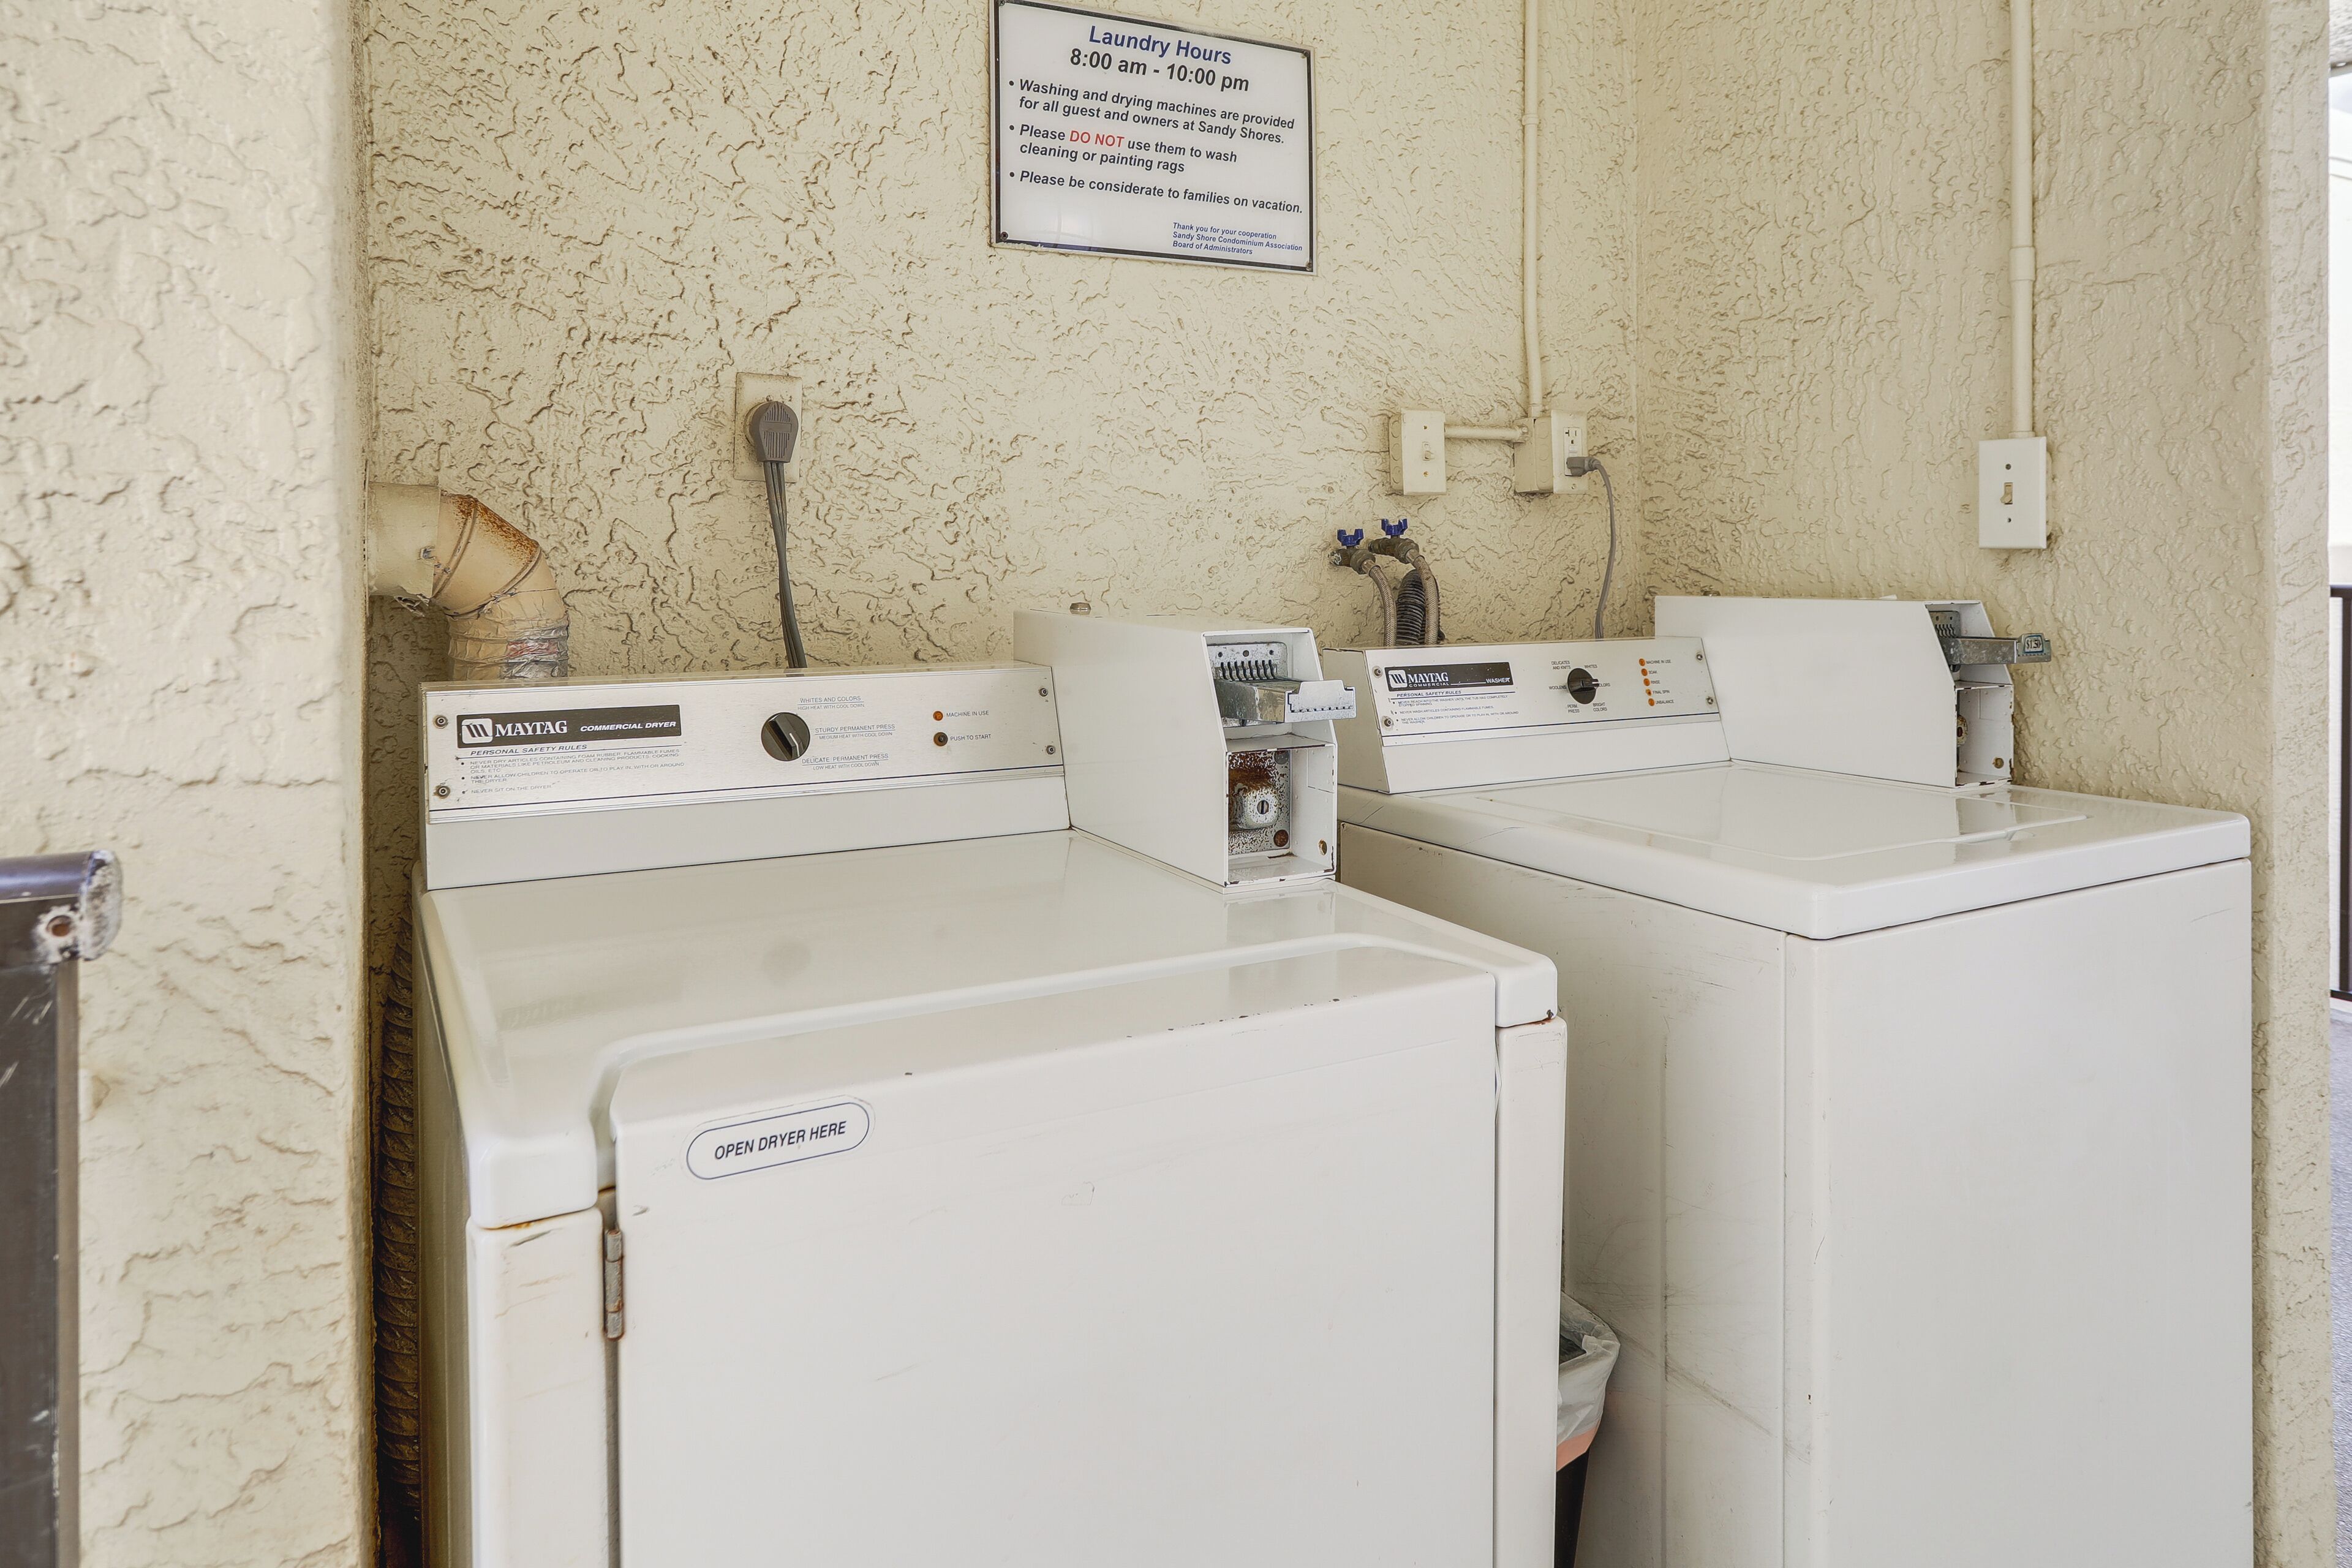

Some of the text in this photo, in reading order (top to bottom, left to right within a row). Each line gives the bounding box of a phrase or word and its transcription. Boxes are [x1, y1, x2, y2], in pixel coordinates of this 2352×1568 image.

[1089, 26, 1231, 64] Laundry Hours
[1070, 48, 1112, 70] 8:00
[1118, 59, 1147, 75] am
[1167, 63, 1216, 86] 10:00
[1221, 76, 1249, 91] pm
[1019, 96, 1284, 143] for all guest and owners at Sandy Shores.
[1020, 78, 1295, 129] Washing and drying machines are provided
[1020, 124, 1237, 162] Please DO NOT use them to wash
[1020, 142, 1185, 173] cleaning or painting rags
[1020, 170, 1303, 213] Please be considerate to families on vacation.
[1173, 222, 1194, 231] Thank
[1238, 230, 1277, 239] cooperation
[1173, 232, 1194, 241] Sandy
[1218, 236, 1264, 247] Condominium
[1265, 241, 1303, 251] Association
[1173, 240, 1194, 249] Board
[1203, 243, 1253, 255] Administrators
[1408, 673, 1449, 683] MAYTAG
[495, 720, 568, 737] MAYTAG
[580, 722, 643, 732] COMMERCIAL
[715, 1121, 846, 1159] OPEN DRYER HERE
